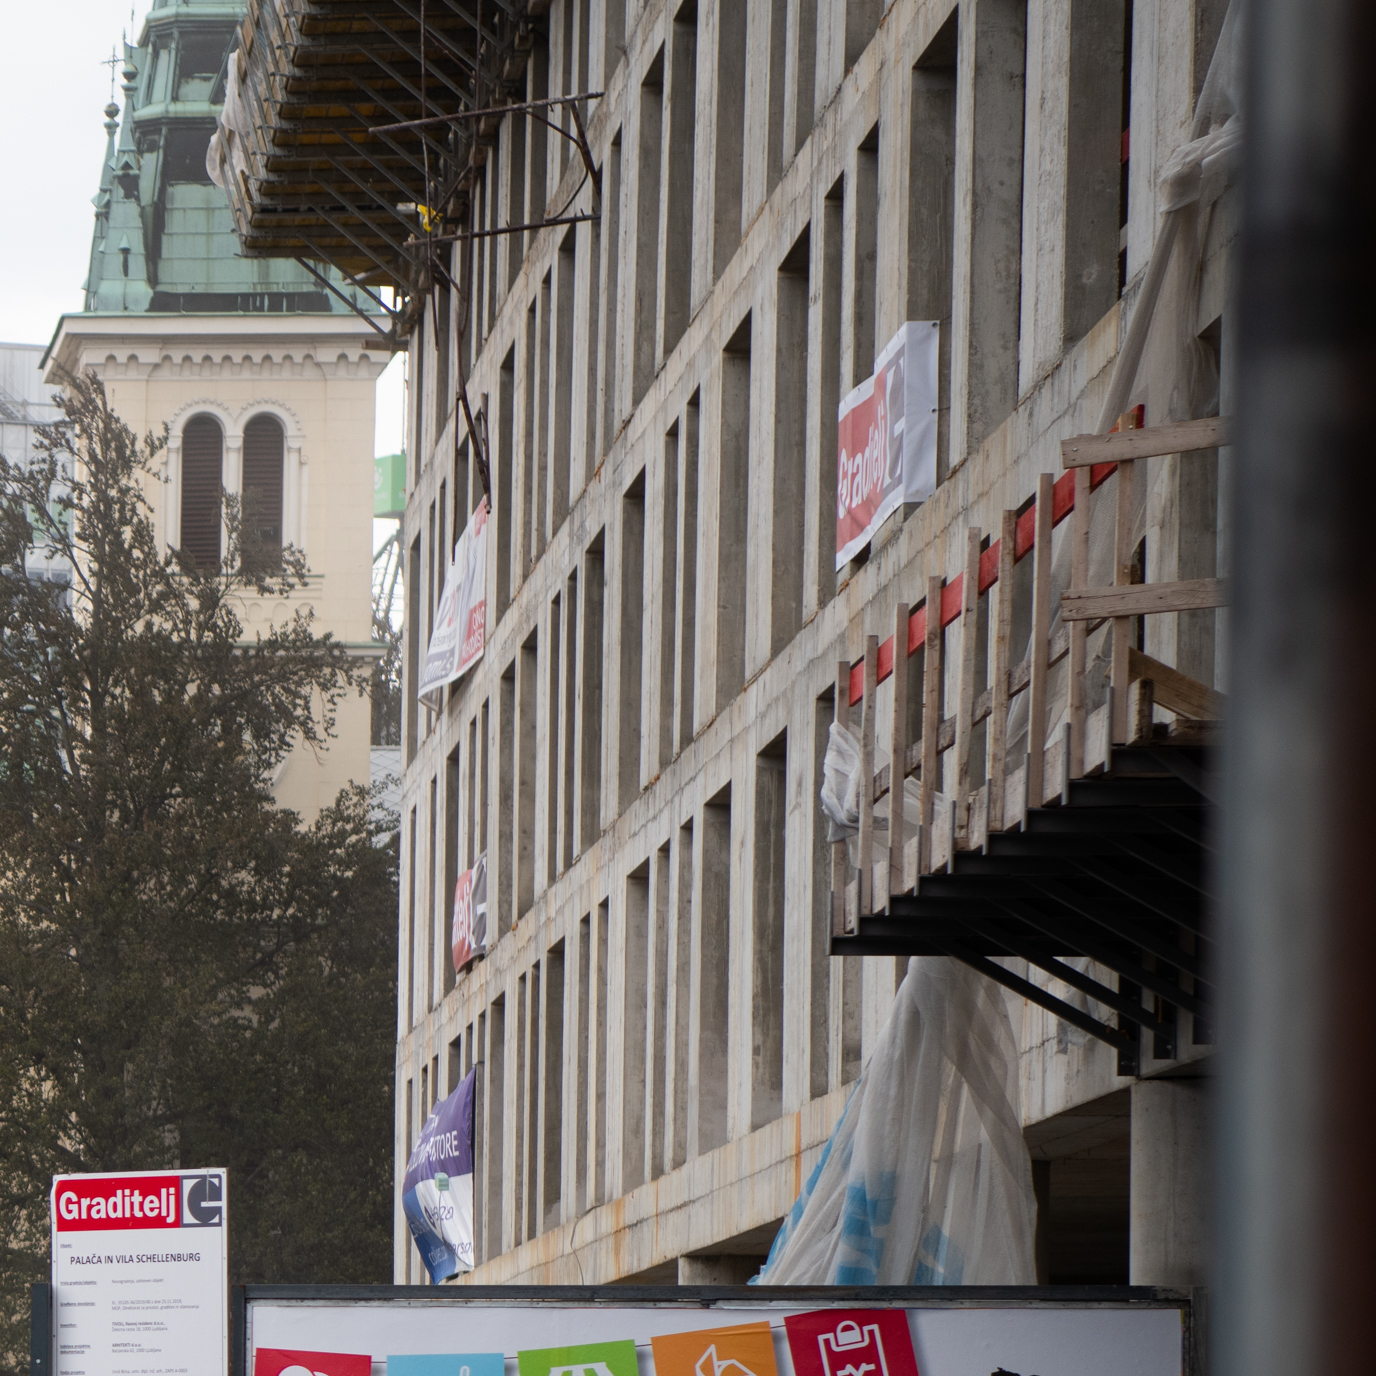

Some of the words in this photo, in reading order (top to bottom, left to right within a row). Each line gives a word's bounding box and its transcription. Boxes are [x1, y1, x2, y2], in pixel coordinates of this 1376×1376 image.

[59, 1188, 176, 1223] Graditelj
[70, 1254, 102, 1265] PALAČA
[104, 1255, 113, 1264] IN
[116, 1255, 134, 1264] VILA
[136, 1253, 201, 1263] SCHELLENBURG
